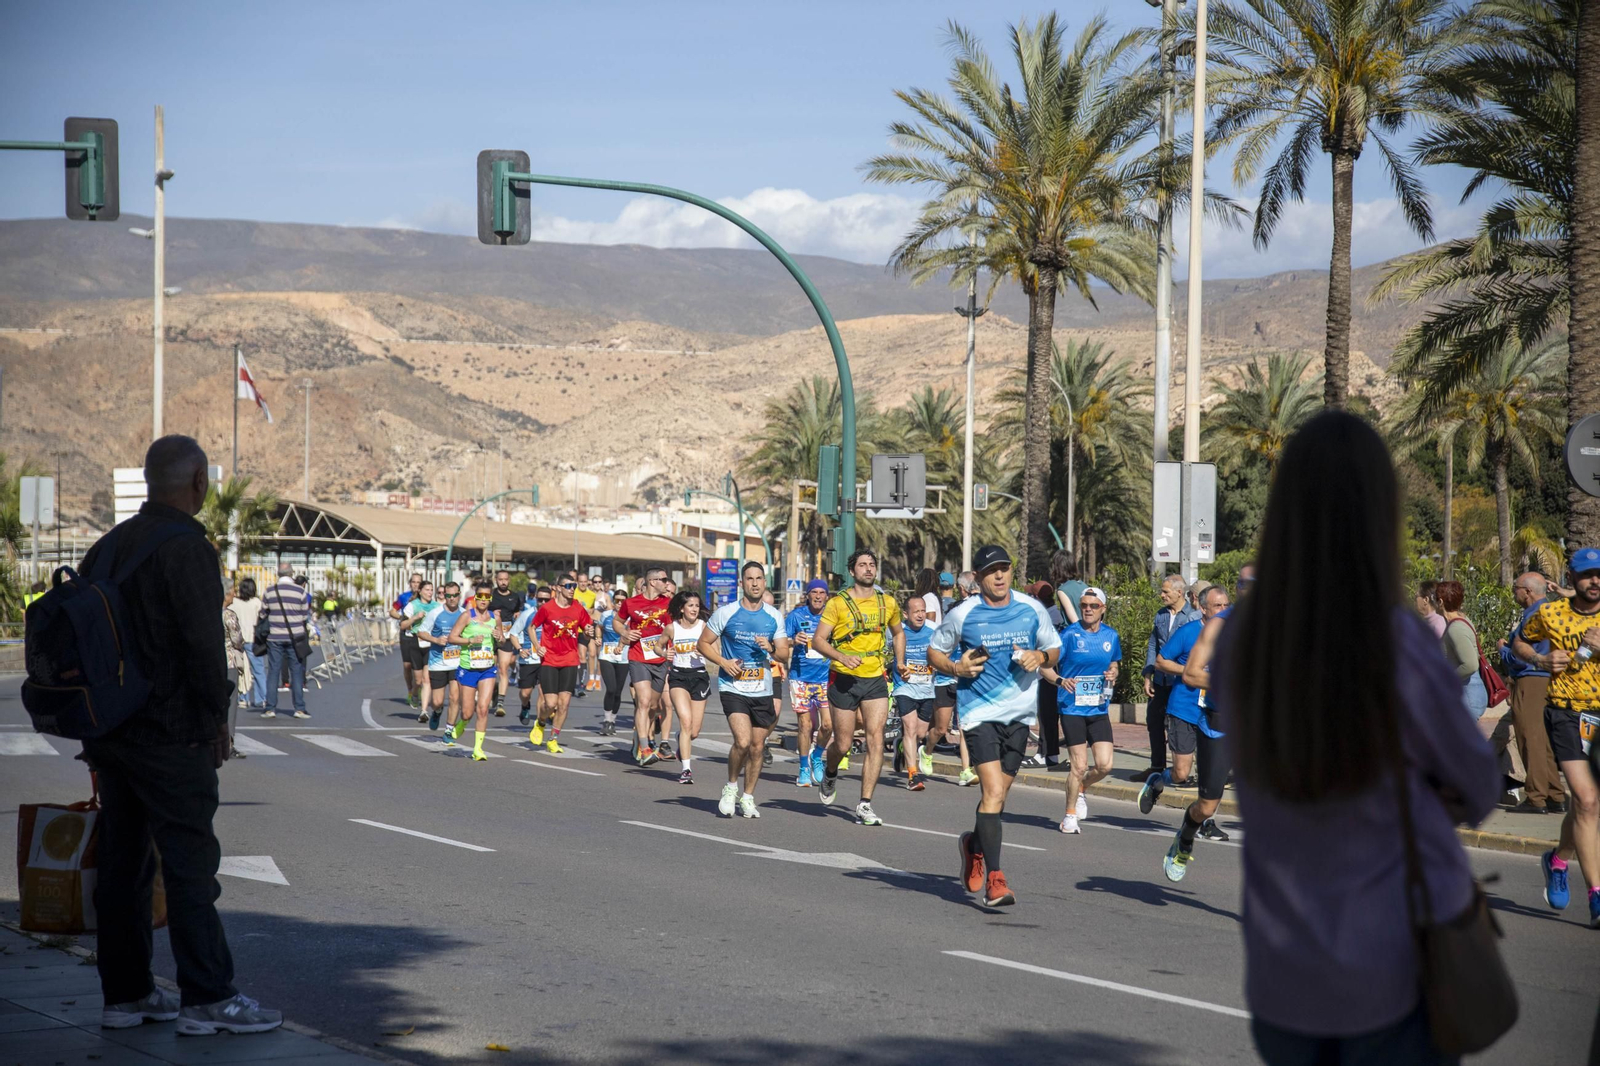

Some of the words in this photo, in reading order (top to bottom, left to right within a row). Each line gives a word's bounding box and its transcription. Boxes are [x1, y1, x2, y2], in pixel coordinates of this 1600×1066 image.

[1003, 630, 1031, 638] Maratón
[982, 639, 1011, 647] Almería
[1011, 636, 1030, 644] 2025
[741, 668, 760, 678] 723
[1082, 682, 1102, 692] 974
[37, 885, 61, 898] 100
[223, 1003, 242, 1017] N
